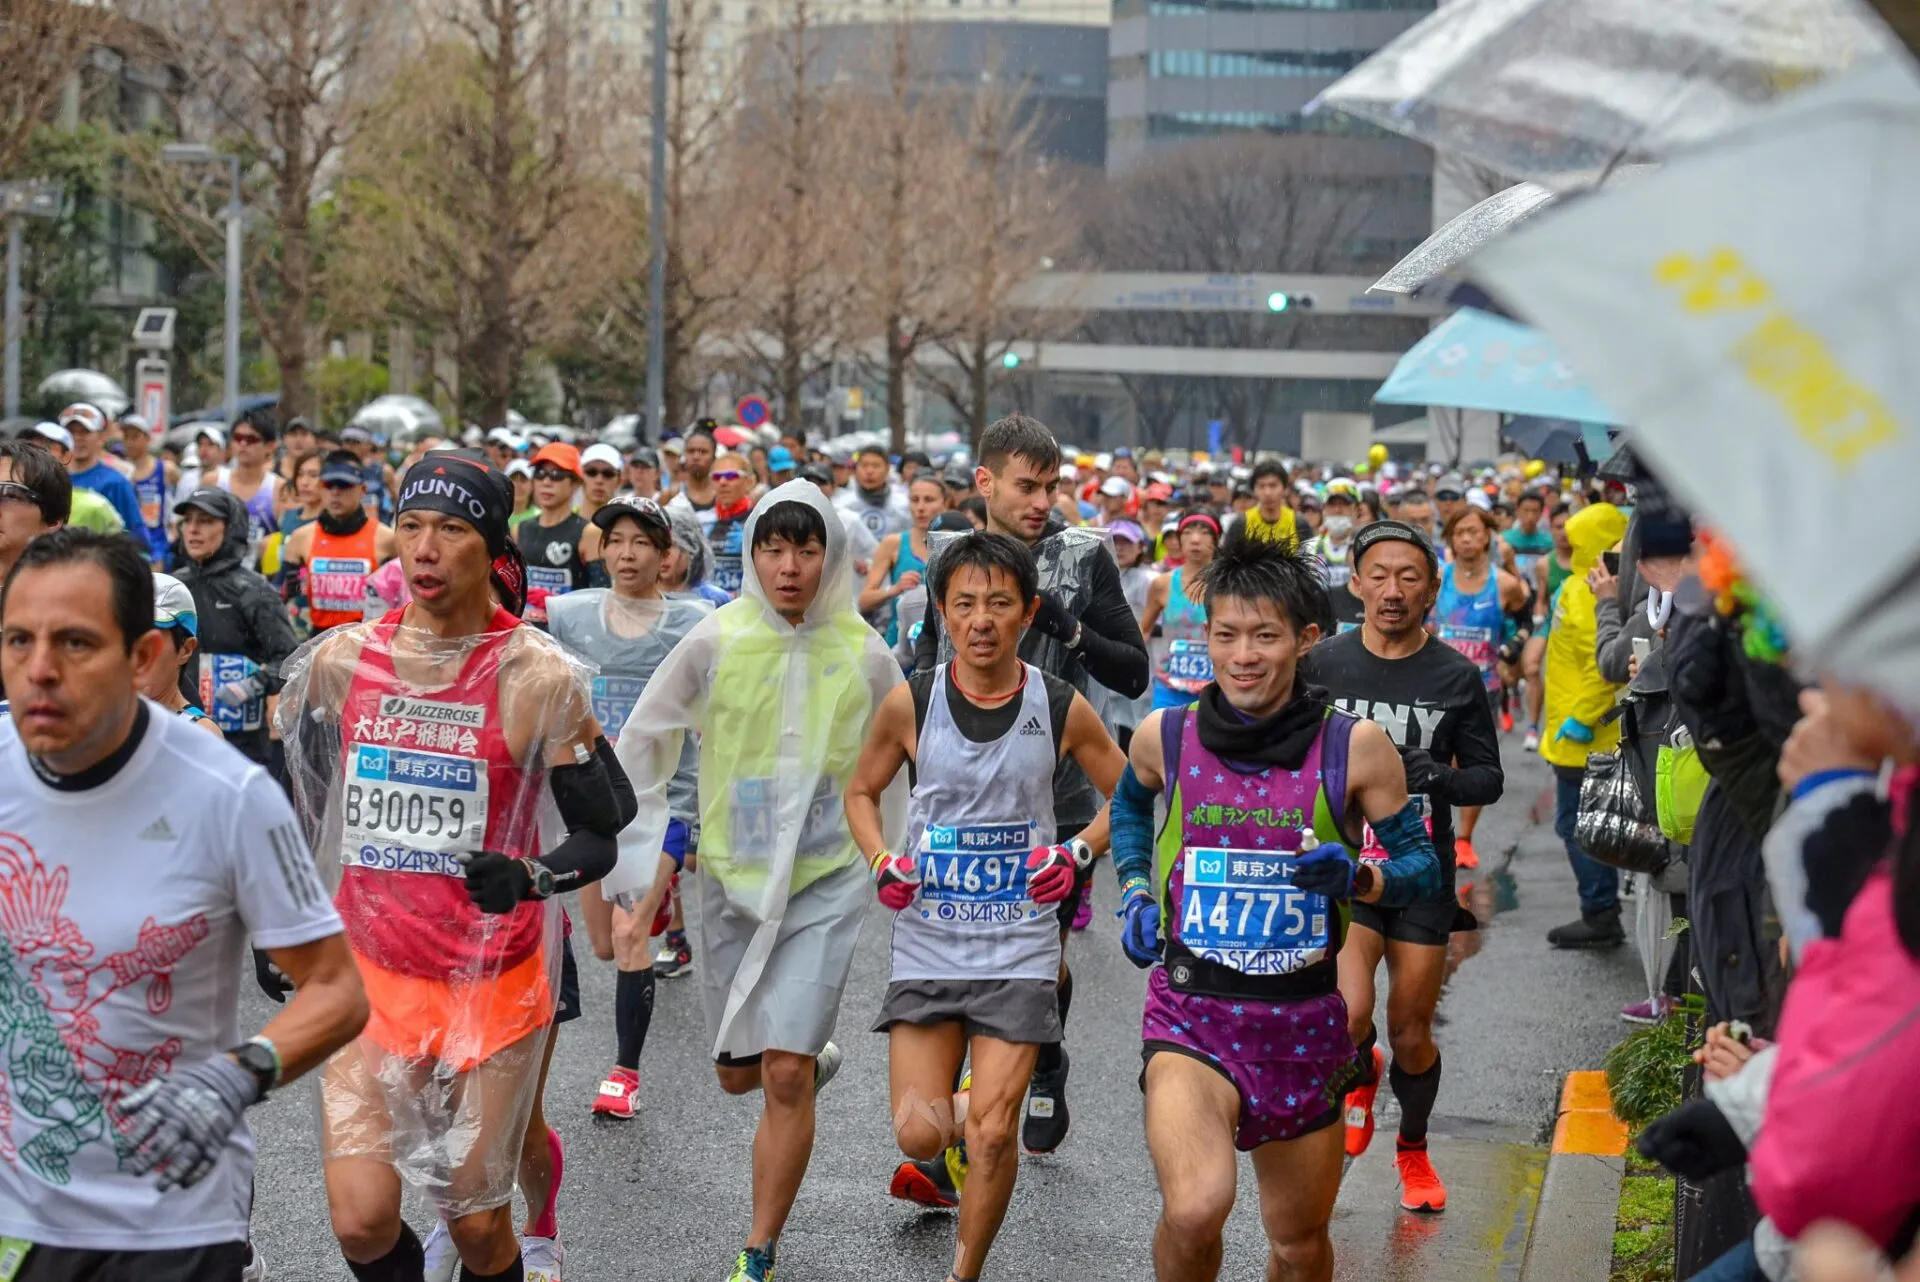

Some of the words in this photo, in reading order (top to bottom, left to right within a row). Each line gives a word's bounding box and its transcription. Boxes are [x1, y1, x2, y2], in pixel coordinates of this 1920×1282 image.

[406, 703, 480, 723] JAZZERCISE
[354, 714, 479, 756] 大江戸飛脚会
[394, 759, 471, 783] 東京メトロ
[346, 784, 465, 839] B90059
[1191, 804, 1304, 829] 水曜ランでしょう
[961, 831, 1025, 846] 東京メトロ
[923, 854, 1020, 893] A4697
[1232, 860, 1296, 878] 東京メト
[959, 902, 1023, 921] STARTS
[1183, 889, 1306, 937] A4775
